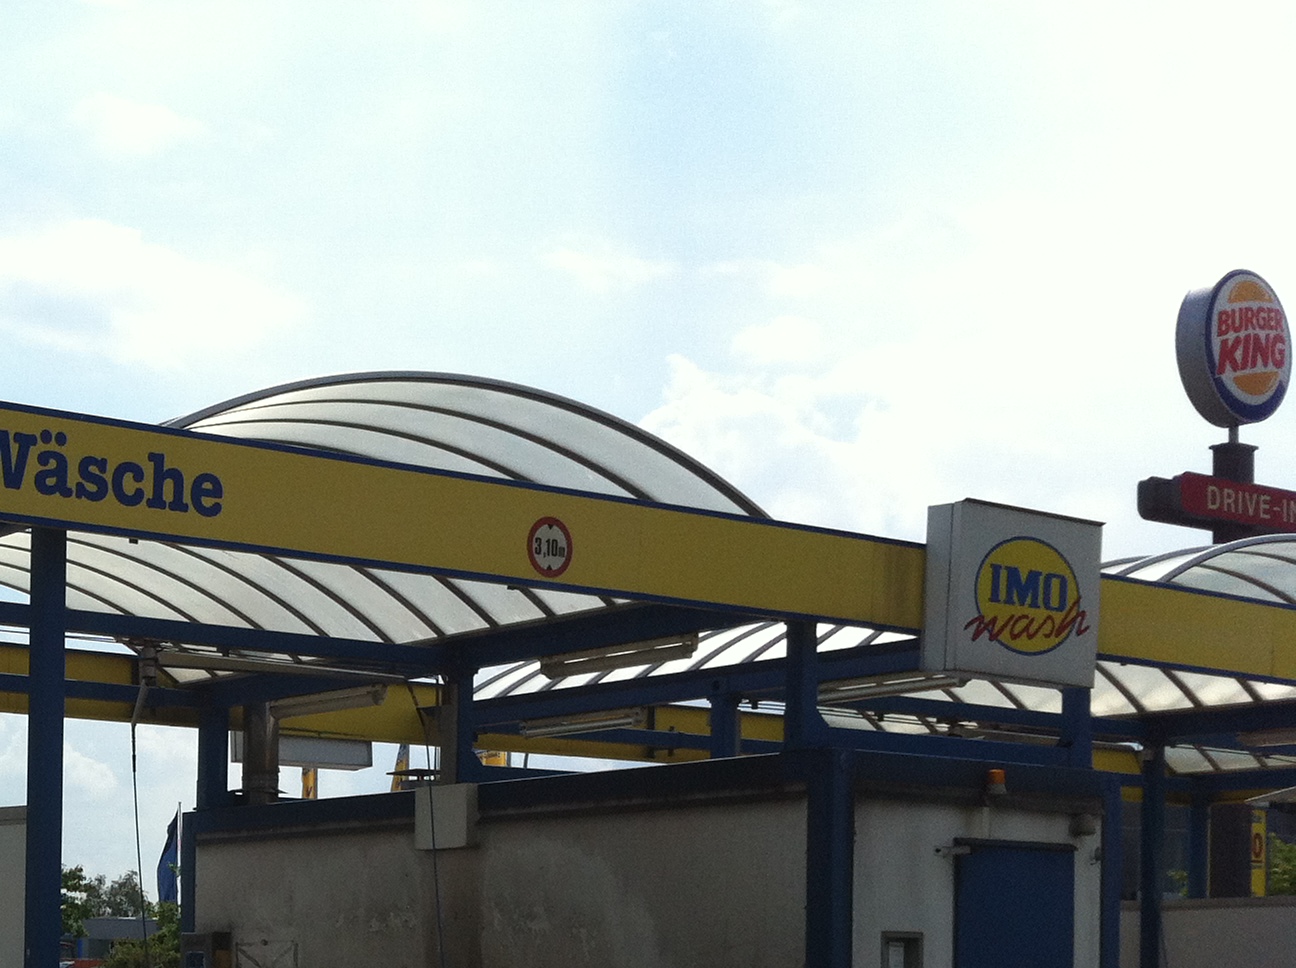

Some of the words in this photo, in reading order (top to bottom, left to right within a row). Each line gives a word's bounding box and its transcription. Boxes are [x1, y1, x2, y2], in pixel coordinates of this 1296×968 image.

[1217, 306, 1285, 337] BURGER
[1217, 332, 1285, 375] KING
[988, 564, 1068, 612] IMO
[963, 596, 1091, 641] wash
